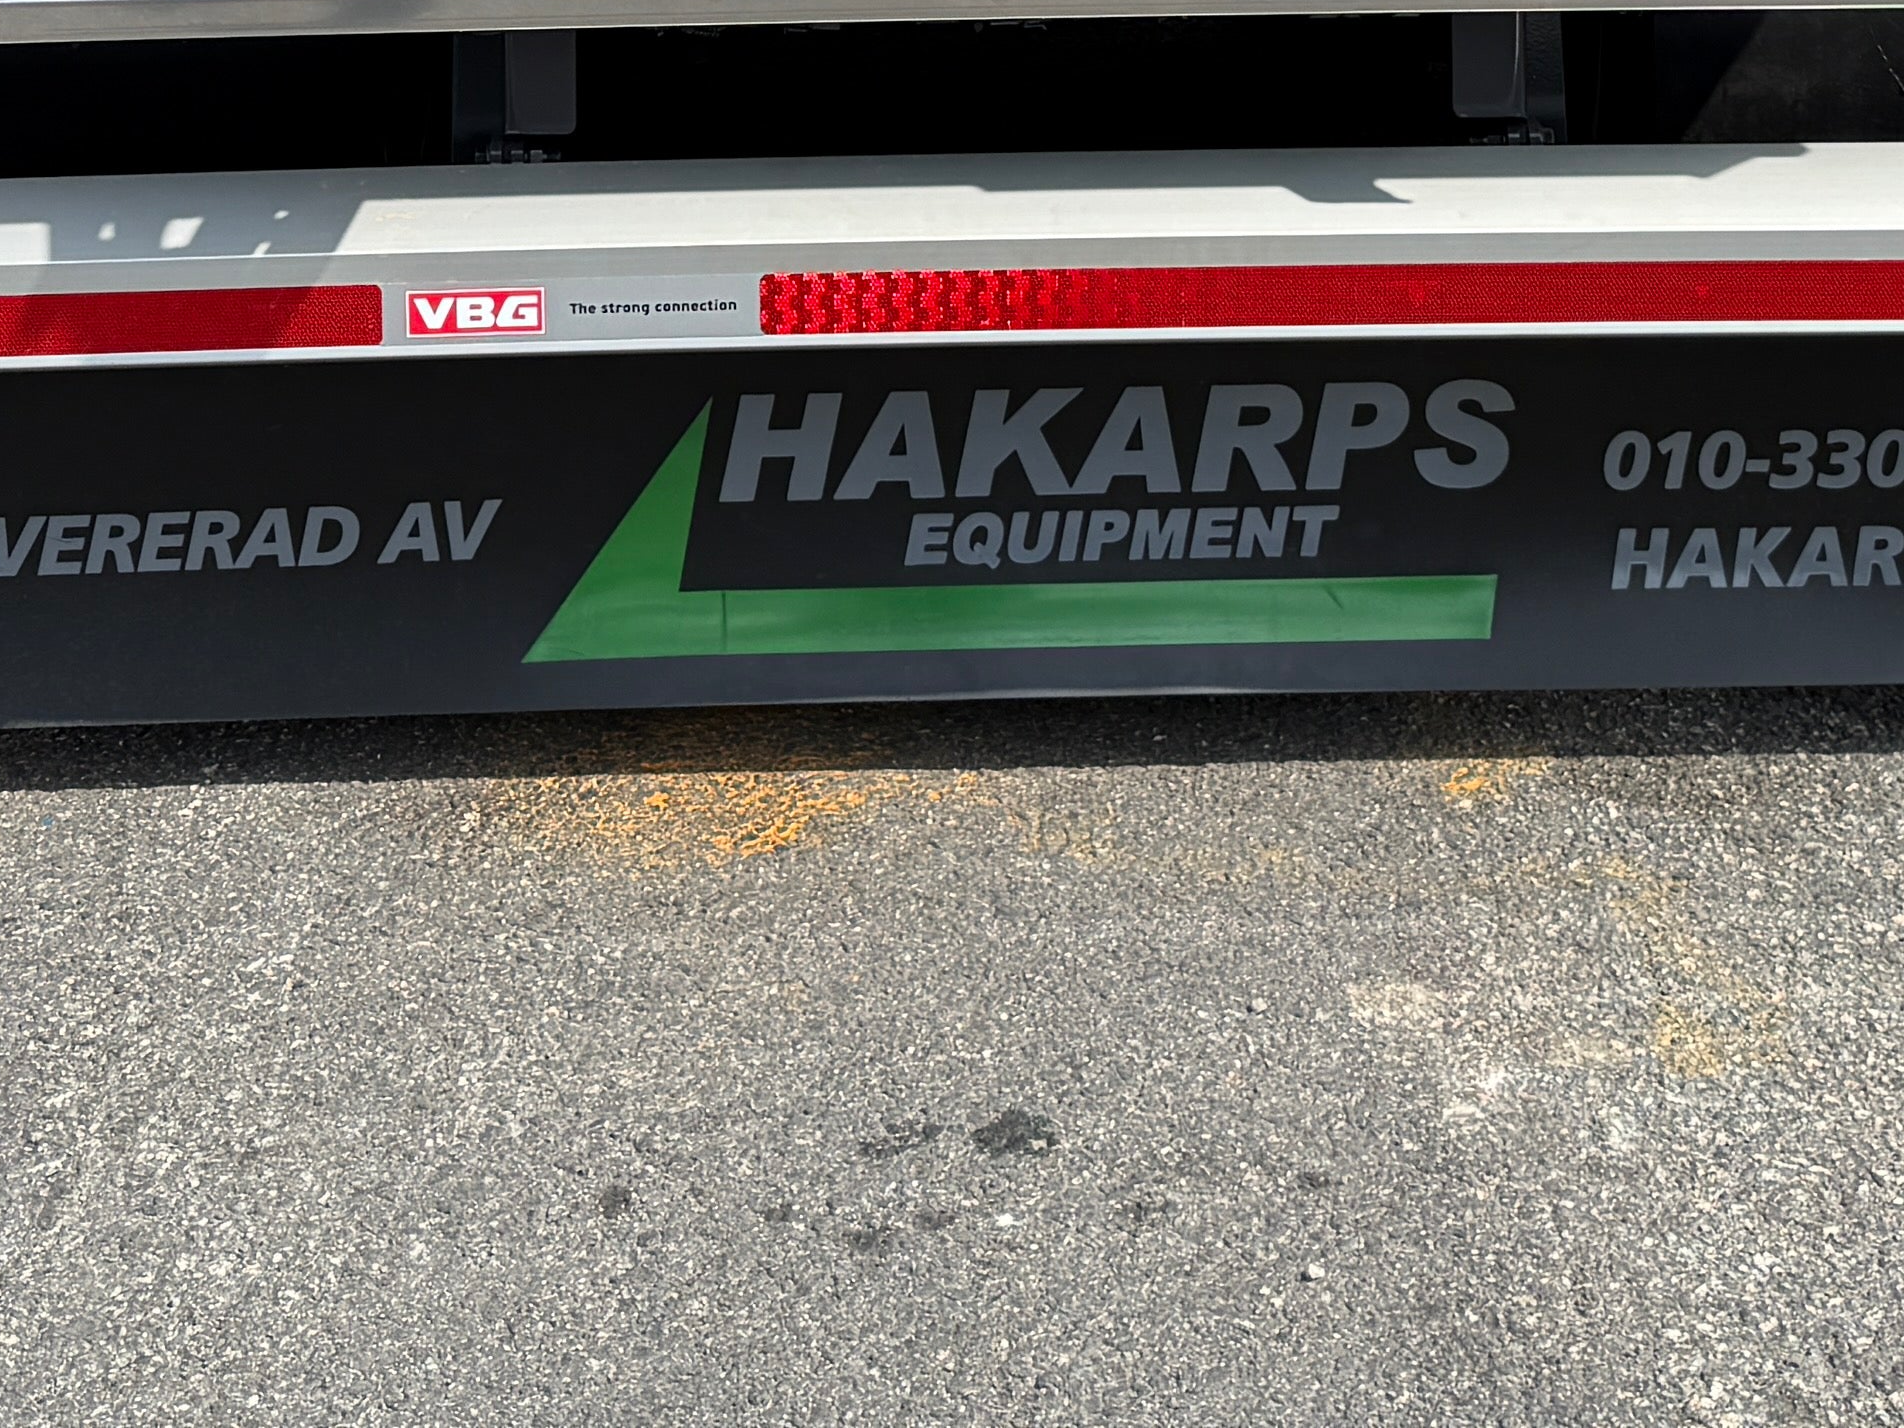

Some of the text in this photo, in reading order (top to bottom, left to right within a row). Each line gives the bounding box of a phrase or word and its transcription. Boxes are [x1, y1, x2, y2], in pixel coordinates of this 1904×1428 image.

[413, 295, 538, 329] VBG
[569, 299, 737, 316] The strong connection
[718, 379, 1516, 502] HAKARPS
[377, 498, 503, 564] AV
[904, 504, 1339, 569] EQUIPMENT
